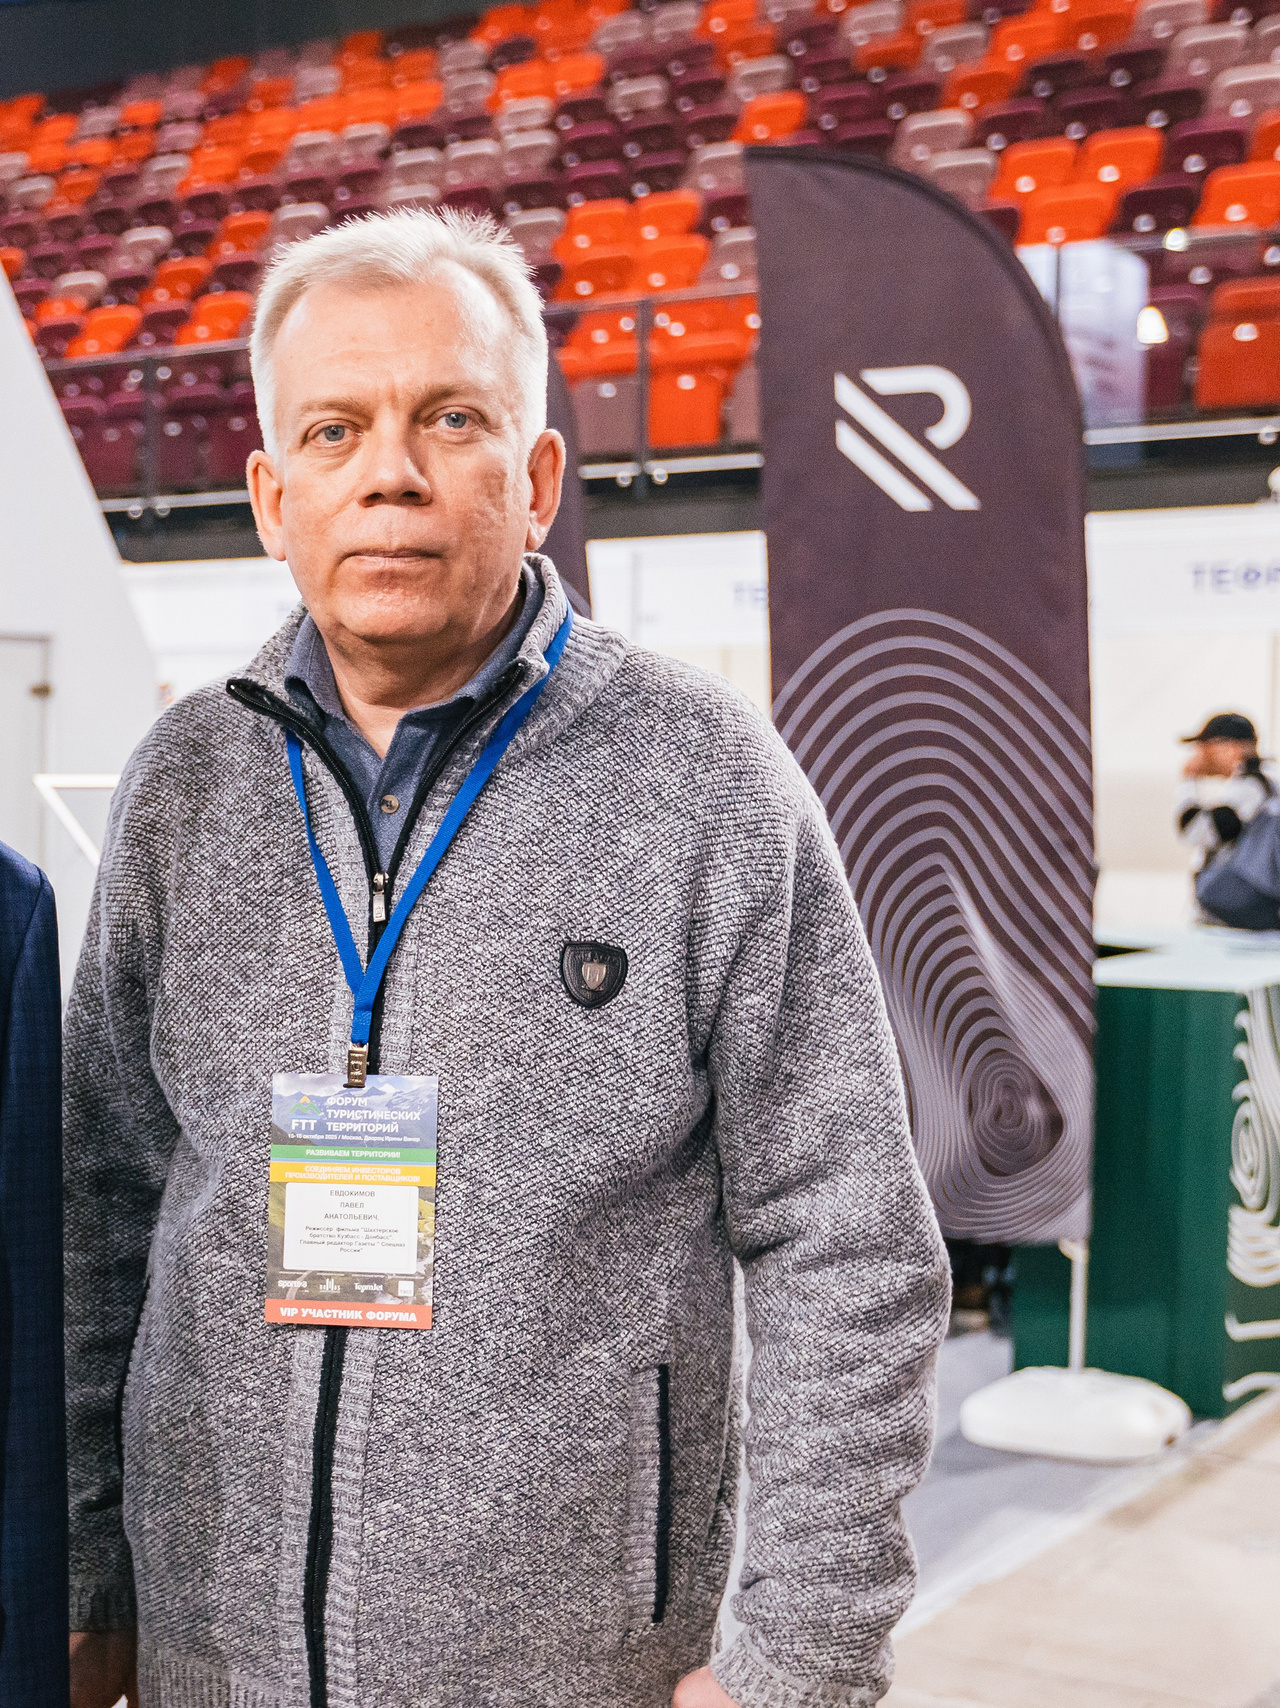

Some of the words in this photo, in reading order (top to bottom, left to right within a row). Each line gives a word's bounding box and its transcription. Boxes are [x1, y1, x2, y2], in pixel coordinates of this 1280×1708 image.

[326, 1096, 368, 1107] ФОРУМ
[326, 1109, 421, 1121] ТУРИСТИЧЕСКИХ
[291, 1119, 318, 1131] FTT
[326, 1121, 399, 1133] ТЕРРИТОРИЙ
[306, 1149, 350, 1157] РАЗВИВАЕМ
[351, 1150, 401, 1158] ТЕРРИТОРИИ!
[304, 1165, 350, 1174] СОЕДИНЯЕМ
[352, 1166, 401, 1175] ИНВЕСТОРОВ
[285, 1172, 353, 1180] ПРОИЗВОДИТЕЛЕЙ
[361, 1174, 421, 1183] ПОСТАВЩИКОВ!
[329, 1189, 376, 1198] ЕВДОКИМОВ
[323, 1213, 380, 1221] АНАТОЛЬЕВИЧ.
[280, 1307, 299, 1317] VIP
[301, 1308, 363, 1320] УЧАСТНИК
[365, 1310, 418, 1322] ФОРУМА
